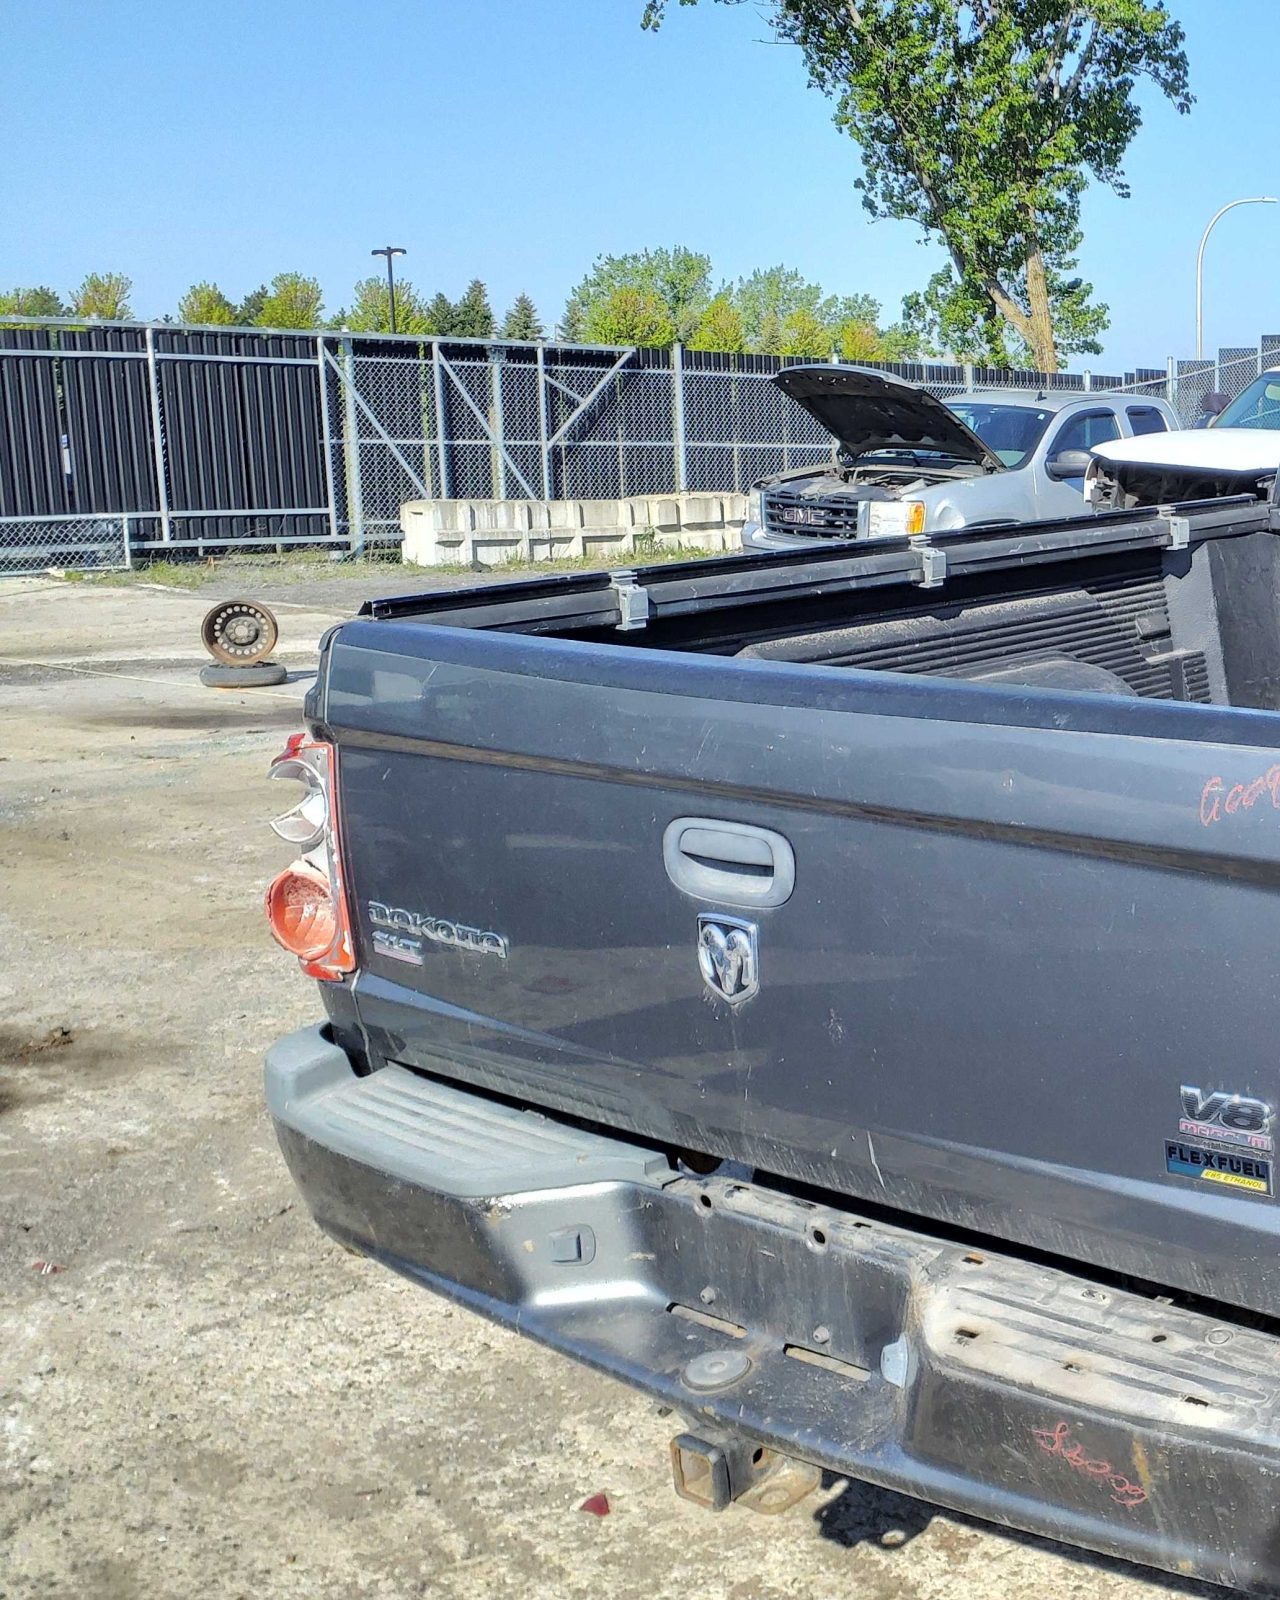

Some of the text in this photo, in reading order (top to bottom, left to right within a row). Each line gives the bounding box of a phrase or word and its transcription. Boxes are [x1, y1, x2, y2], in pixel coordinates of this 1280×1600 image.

[782, 507, 826, 526] GMC
[368, 900, 508, 959] DAKOTA
[1180, 1085, 1271, 1135] V8
[1167, 1146, 1266, 1179] FLEXFUEL
[1204, 1170, 1264, 1189] E85 ETHANOL
